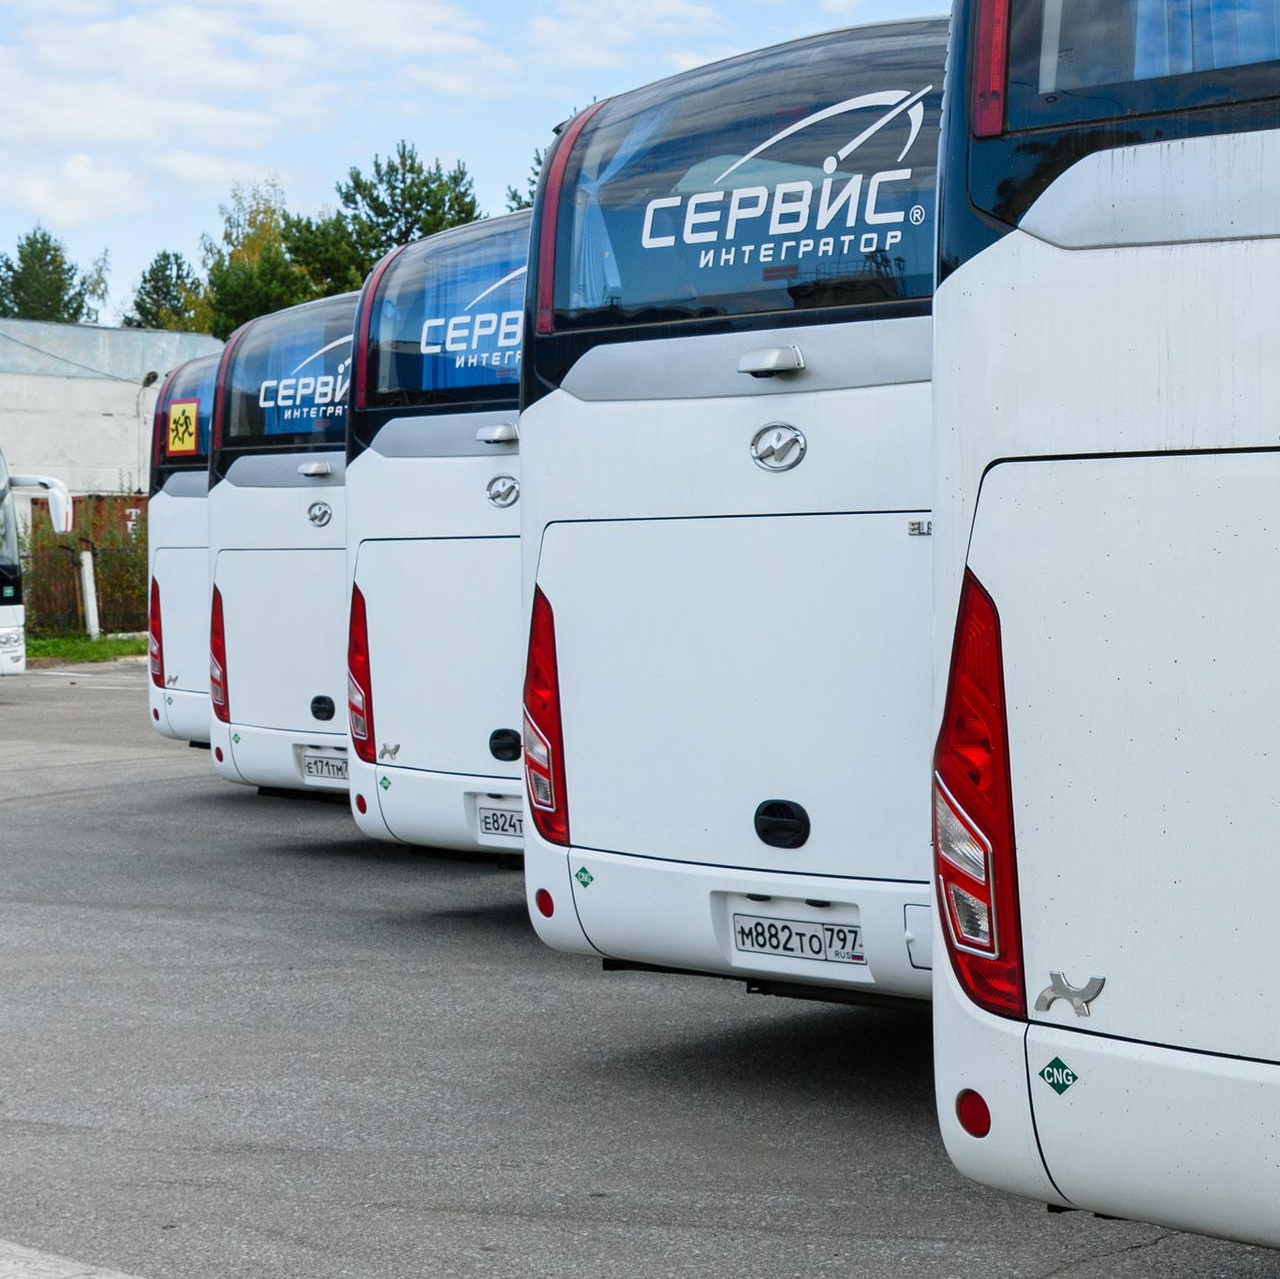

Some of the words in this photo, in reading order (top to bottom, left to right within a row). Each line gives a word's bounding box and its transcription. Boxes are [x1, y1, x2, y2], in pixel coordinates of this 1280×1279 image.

[699, 230, 902, 268] ИНТЕГРАТОР
[283, 405, 348, 420] ИНТЕГРА
[825, 927, 858, 951] 797
[834, 950, 851, 960] RUS
[1044, 1067, 1073, 1085] CNG
